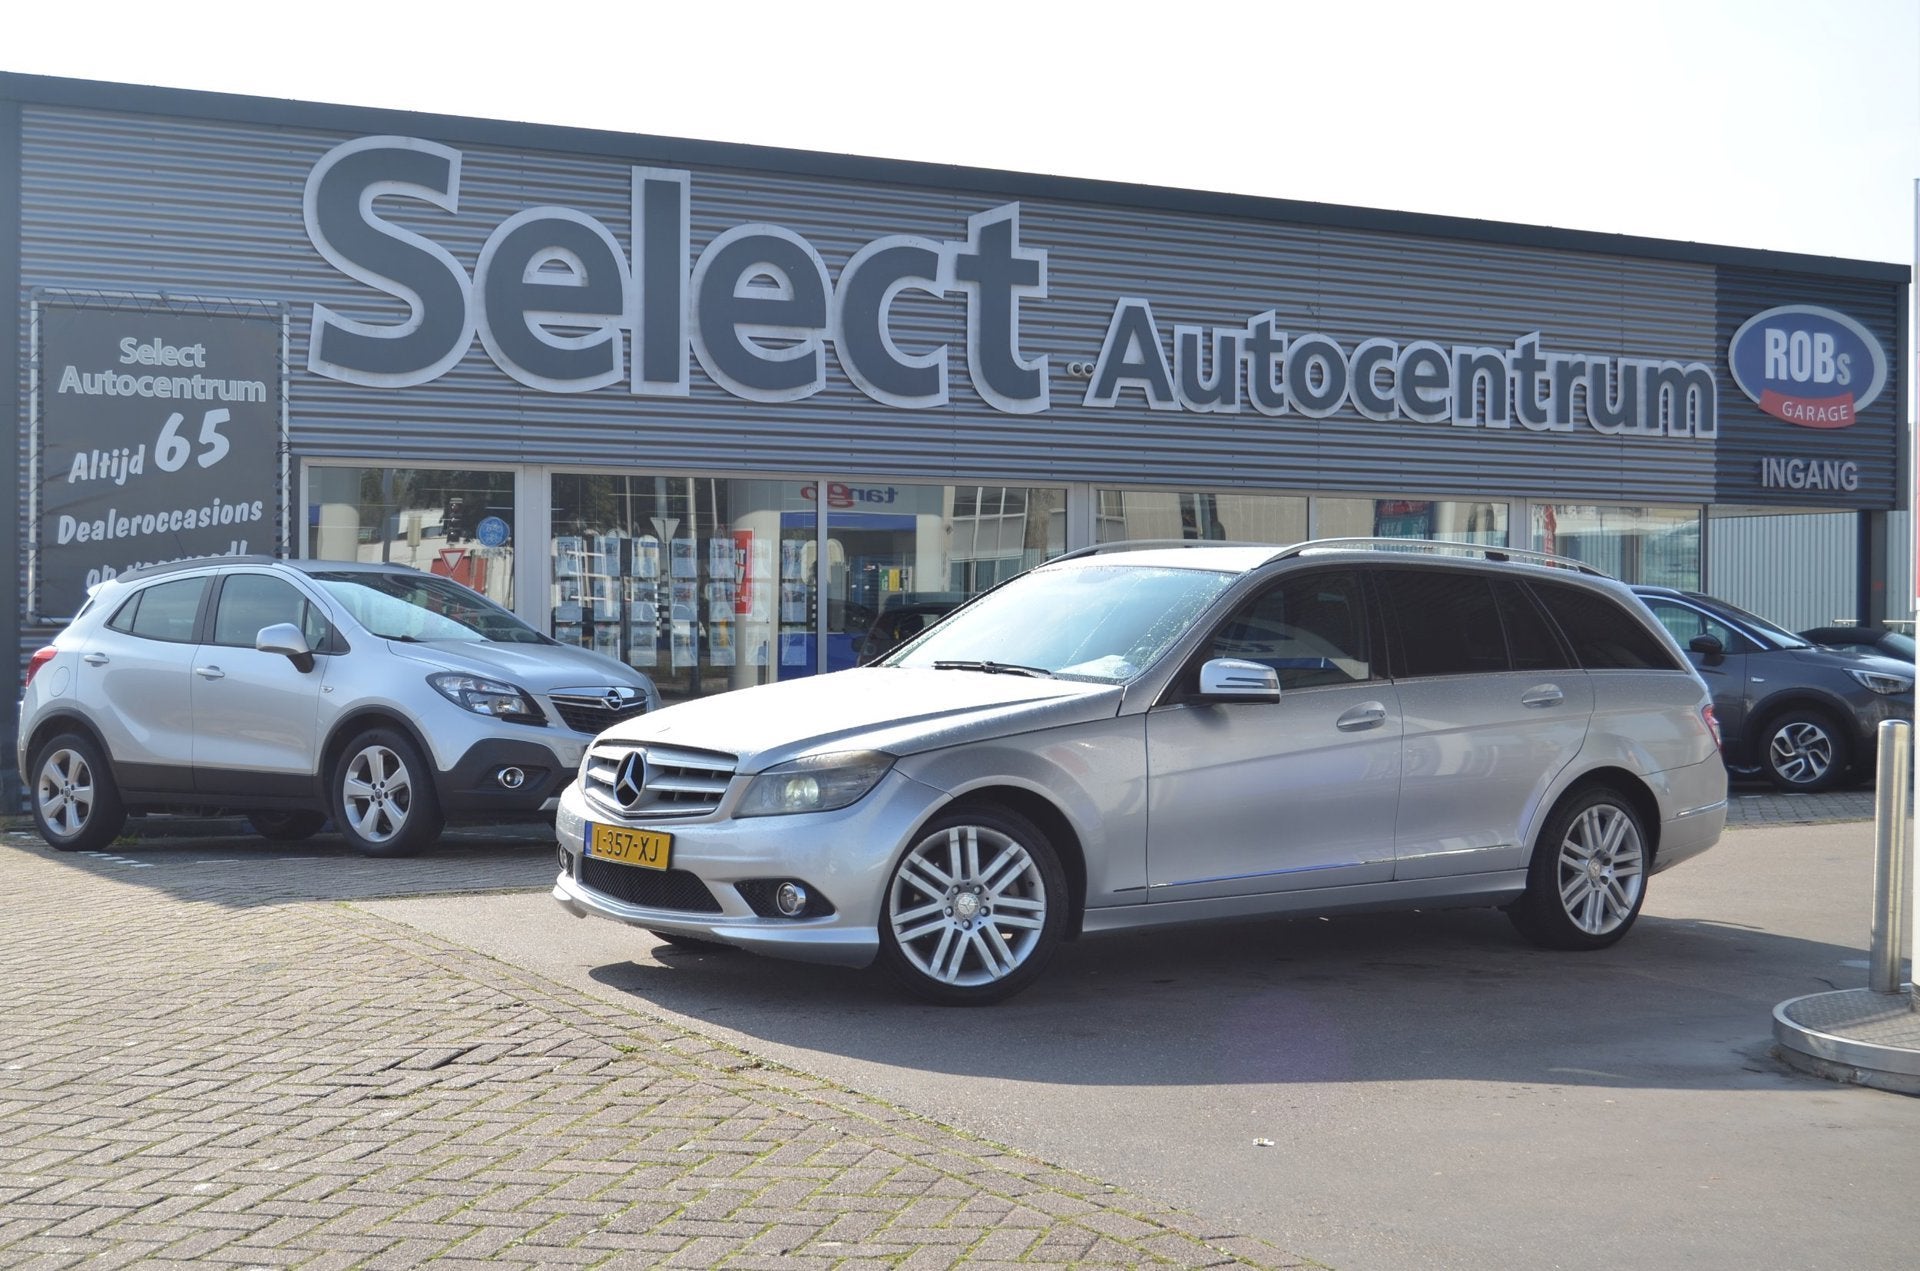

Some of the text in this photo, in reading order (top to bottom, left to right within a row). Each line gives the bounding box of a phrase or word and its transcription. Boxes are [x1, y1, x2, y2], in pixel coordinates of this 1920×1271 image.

[303, 135, 1718, 440] Select Autocentrum
[119, 337, 205, 368] Select
[1764, 327, 1851, 386] ROBs
[58, 365, 266, 402] Autocentrum
[1782, 401, 1849, 422] GARAGE
[68, 408, 230, 486] Altijd 65
[1761, 457, 1858, 491] INGANG
[57, 497, 263, 544] Dealeroccasions
[596, 829, 659, 862] L-357-XJ
